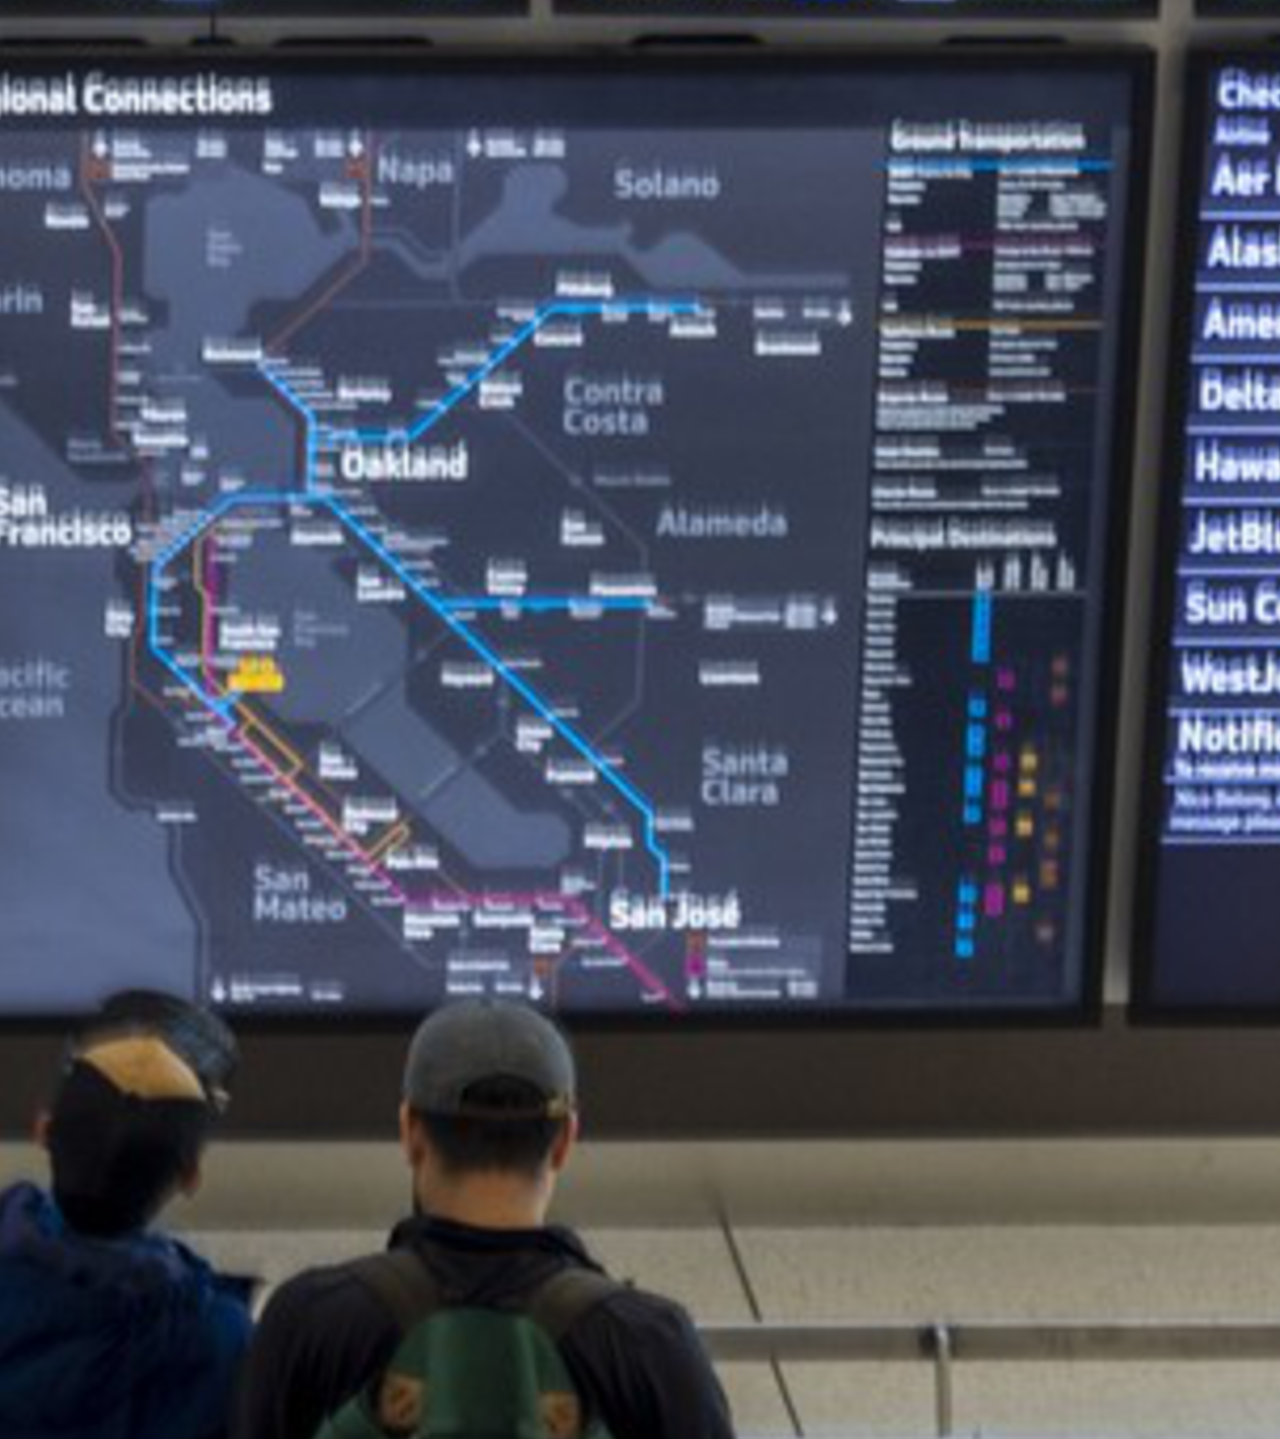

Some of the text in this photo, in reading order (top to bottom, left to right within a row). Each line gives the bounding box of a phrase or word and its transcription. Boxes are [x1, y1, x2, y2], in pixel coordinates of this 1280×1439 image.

[83, 74, 272, 115] Connections
[378, 156, 453, 189] Napa
[614, 167, 720, 200] Solano
[1212, 155, 1271, 197] Aer
[564, 375, 663, 404] Contra
[564, 407, 648, 436] Costa
[342, 443, 467, 480] Oakland
[657, 507, 788, 536] Alameda
[1185, 583, 1247, 624] Sun
[702, 744, 789, 776] Santa
[702, 777, 778, 805] Clara
[255, 862, 309, 893] San
[254, 894, 346, 922] Mateo
[610, 890, 740, 929] San José
